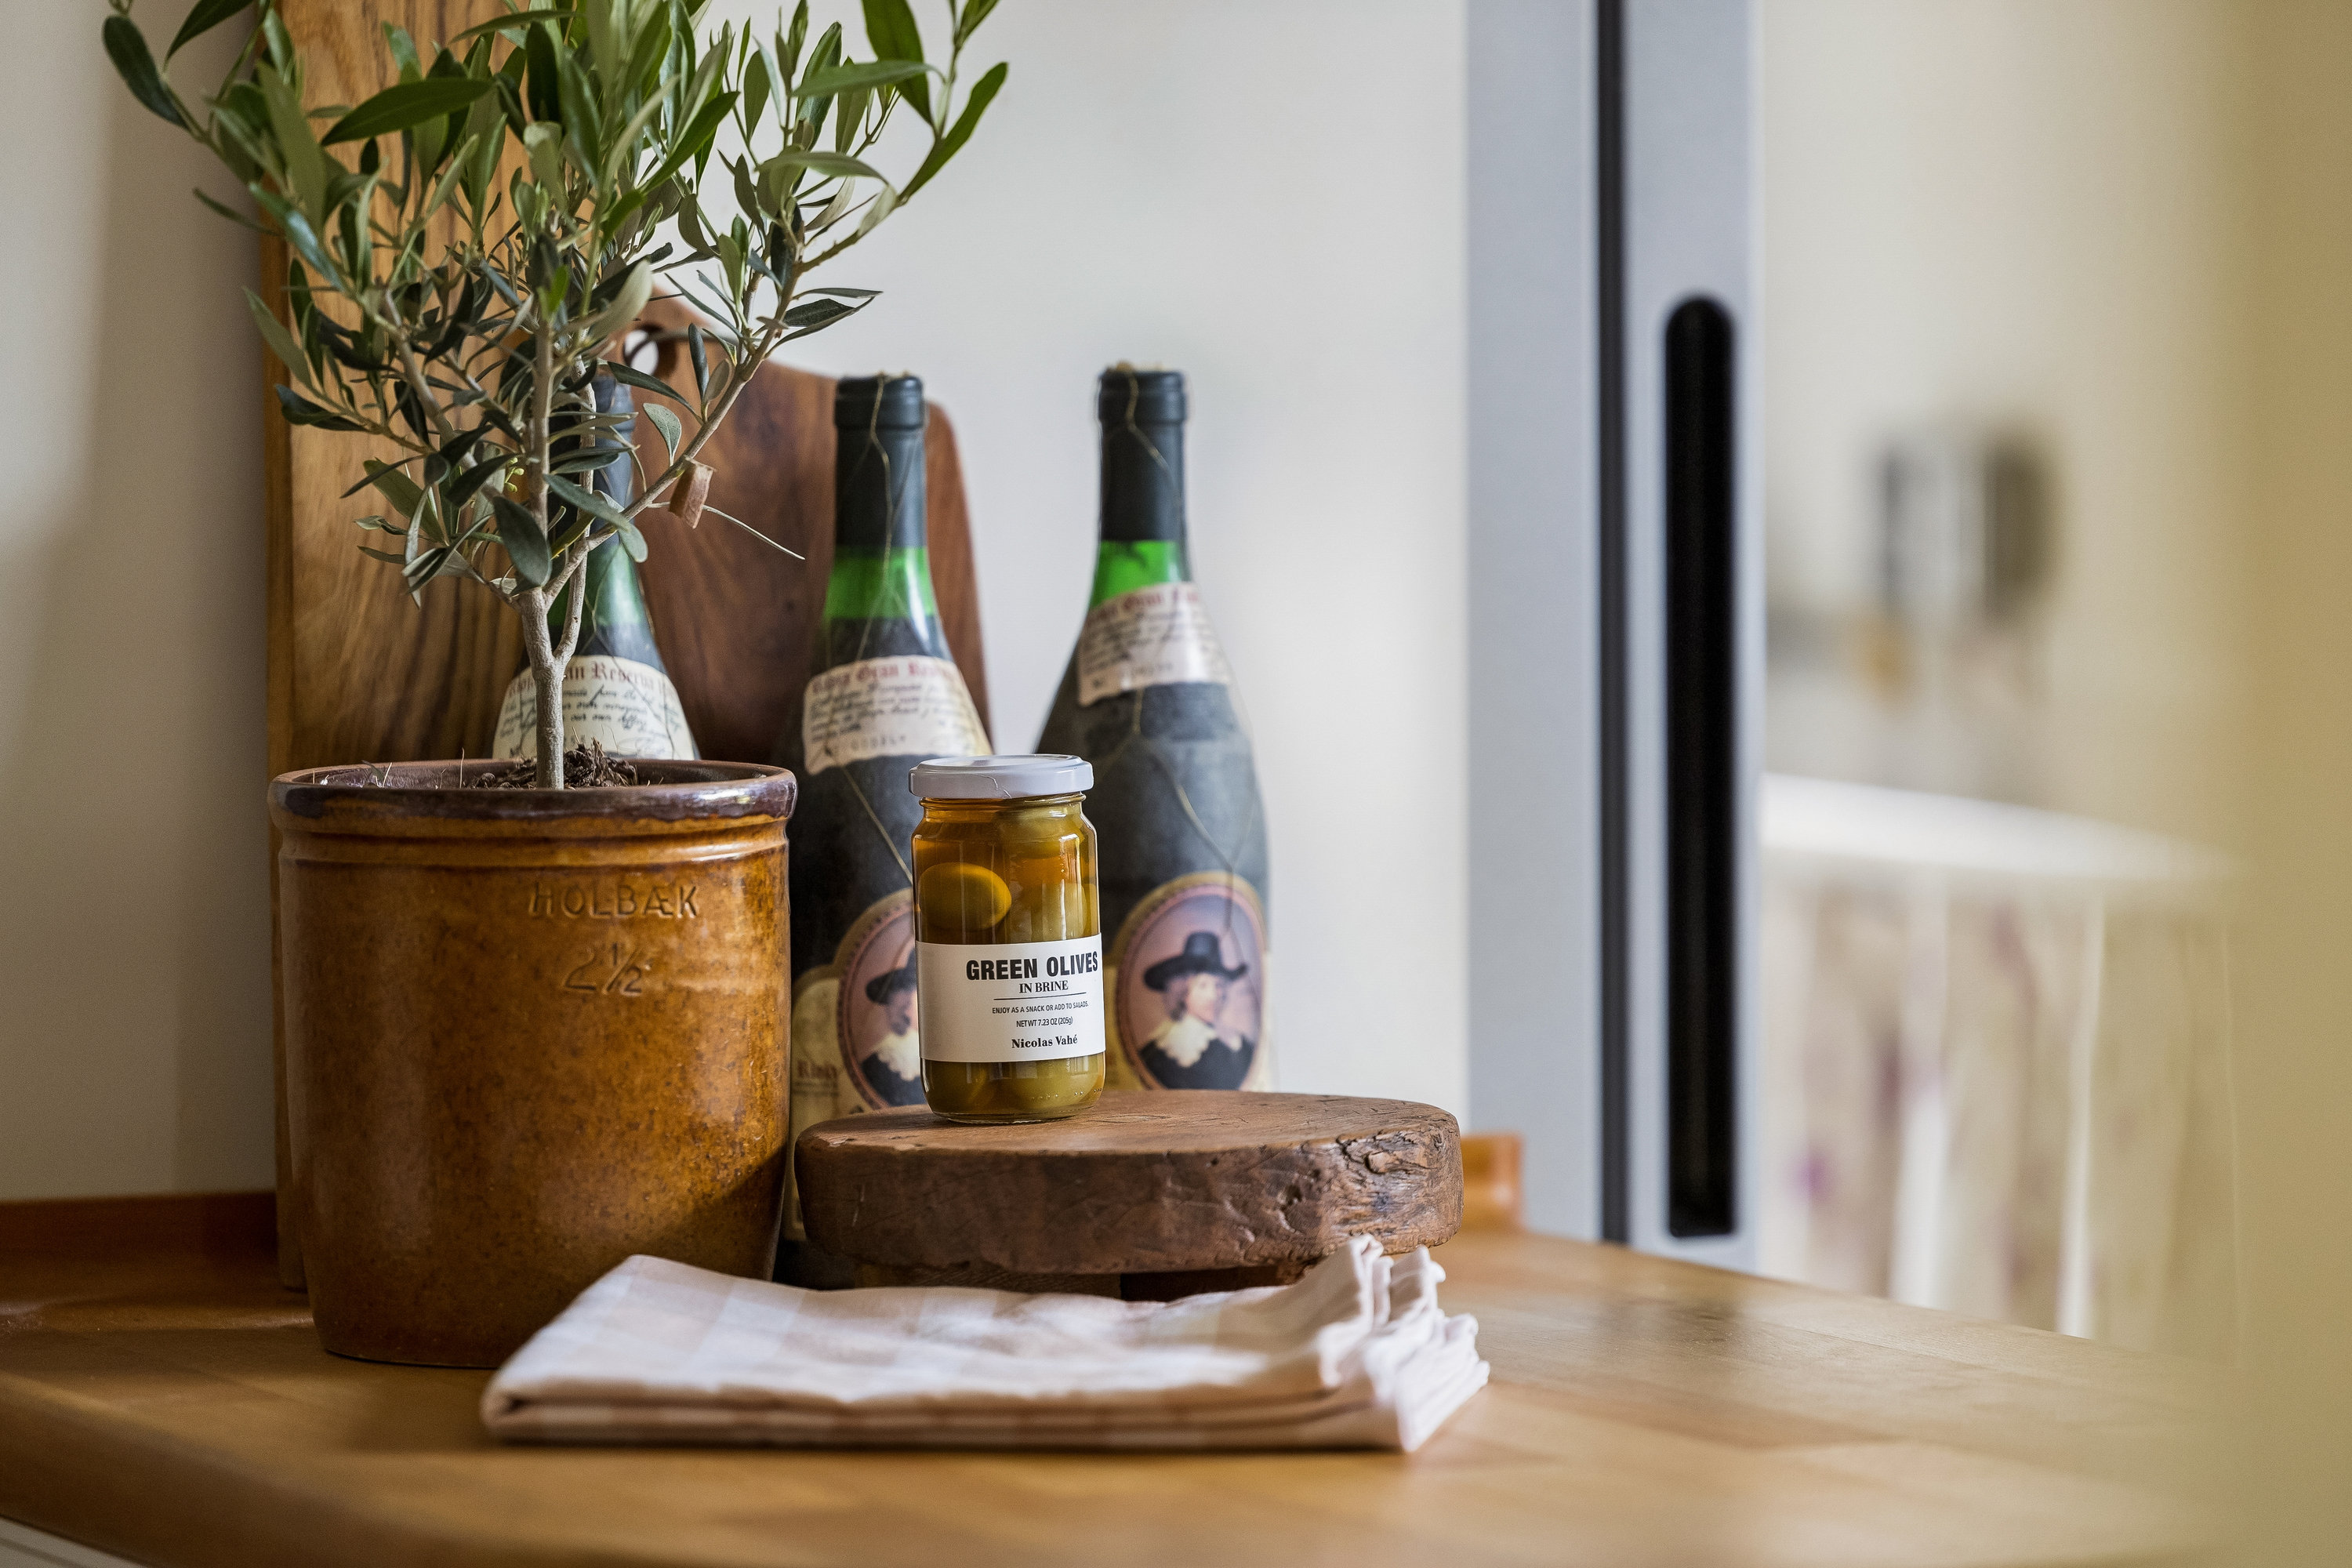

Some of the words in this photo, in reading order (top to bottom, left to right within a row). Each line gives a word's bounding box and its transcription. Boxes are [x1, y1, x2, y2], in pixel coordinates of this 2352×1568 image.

[528, 882, 697, 919] HOLBÆK
[966, 958, 1038, 981] GREEN
[1046, 950, 1098, 977] OLIVES
[1018, 982, 1033, 993] IN
[1035, 980, 1069, 993] BRINE
[1058, 1016, 1073, 1025] (205g)
[1011, 1037, 1053, 1048] Nicolas
[1055, 1034, 1078, 1045] Vahé
